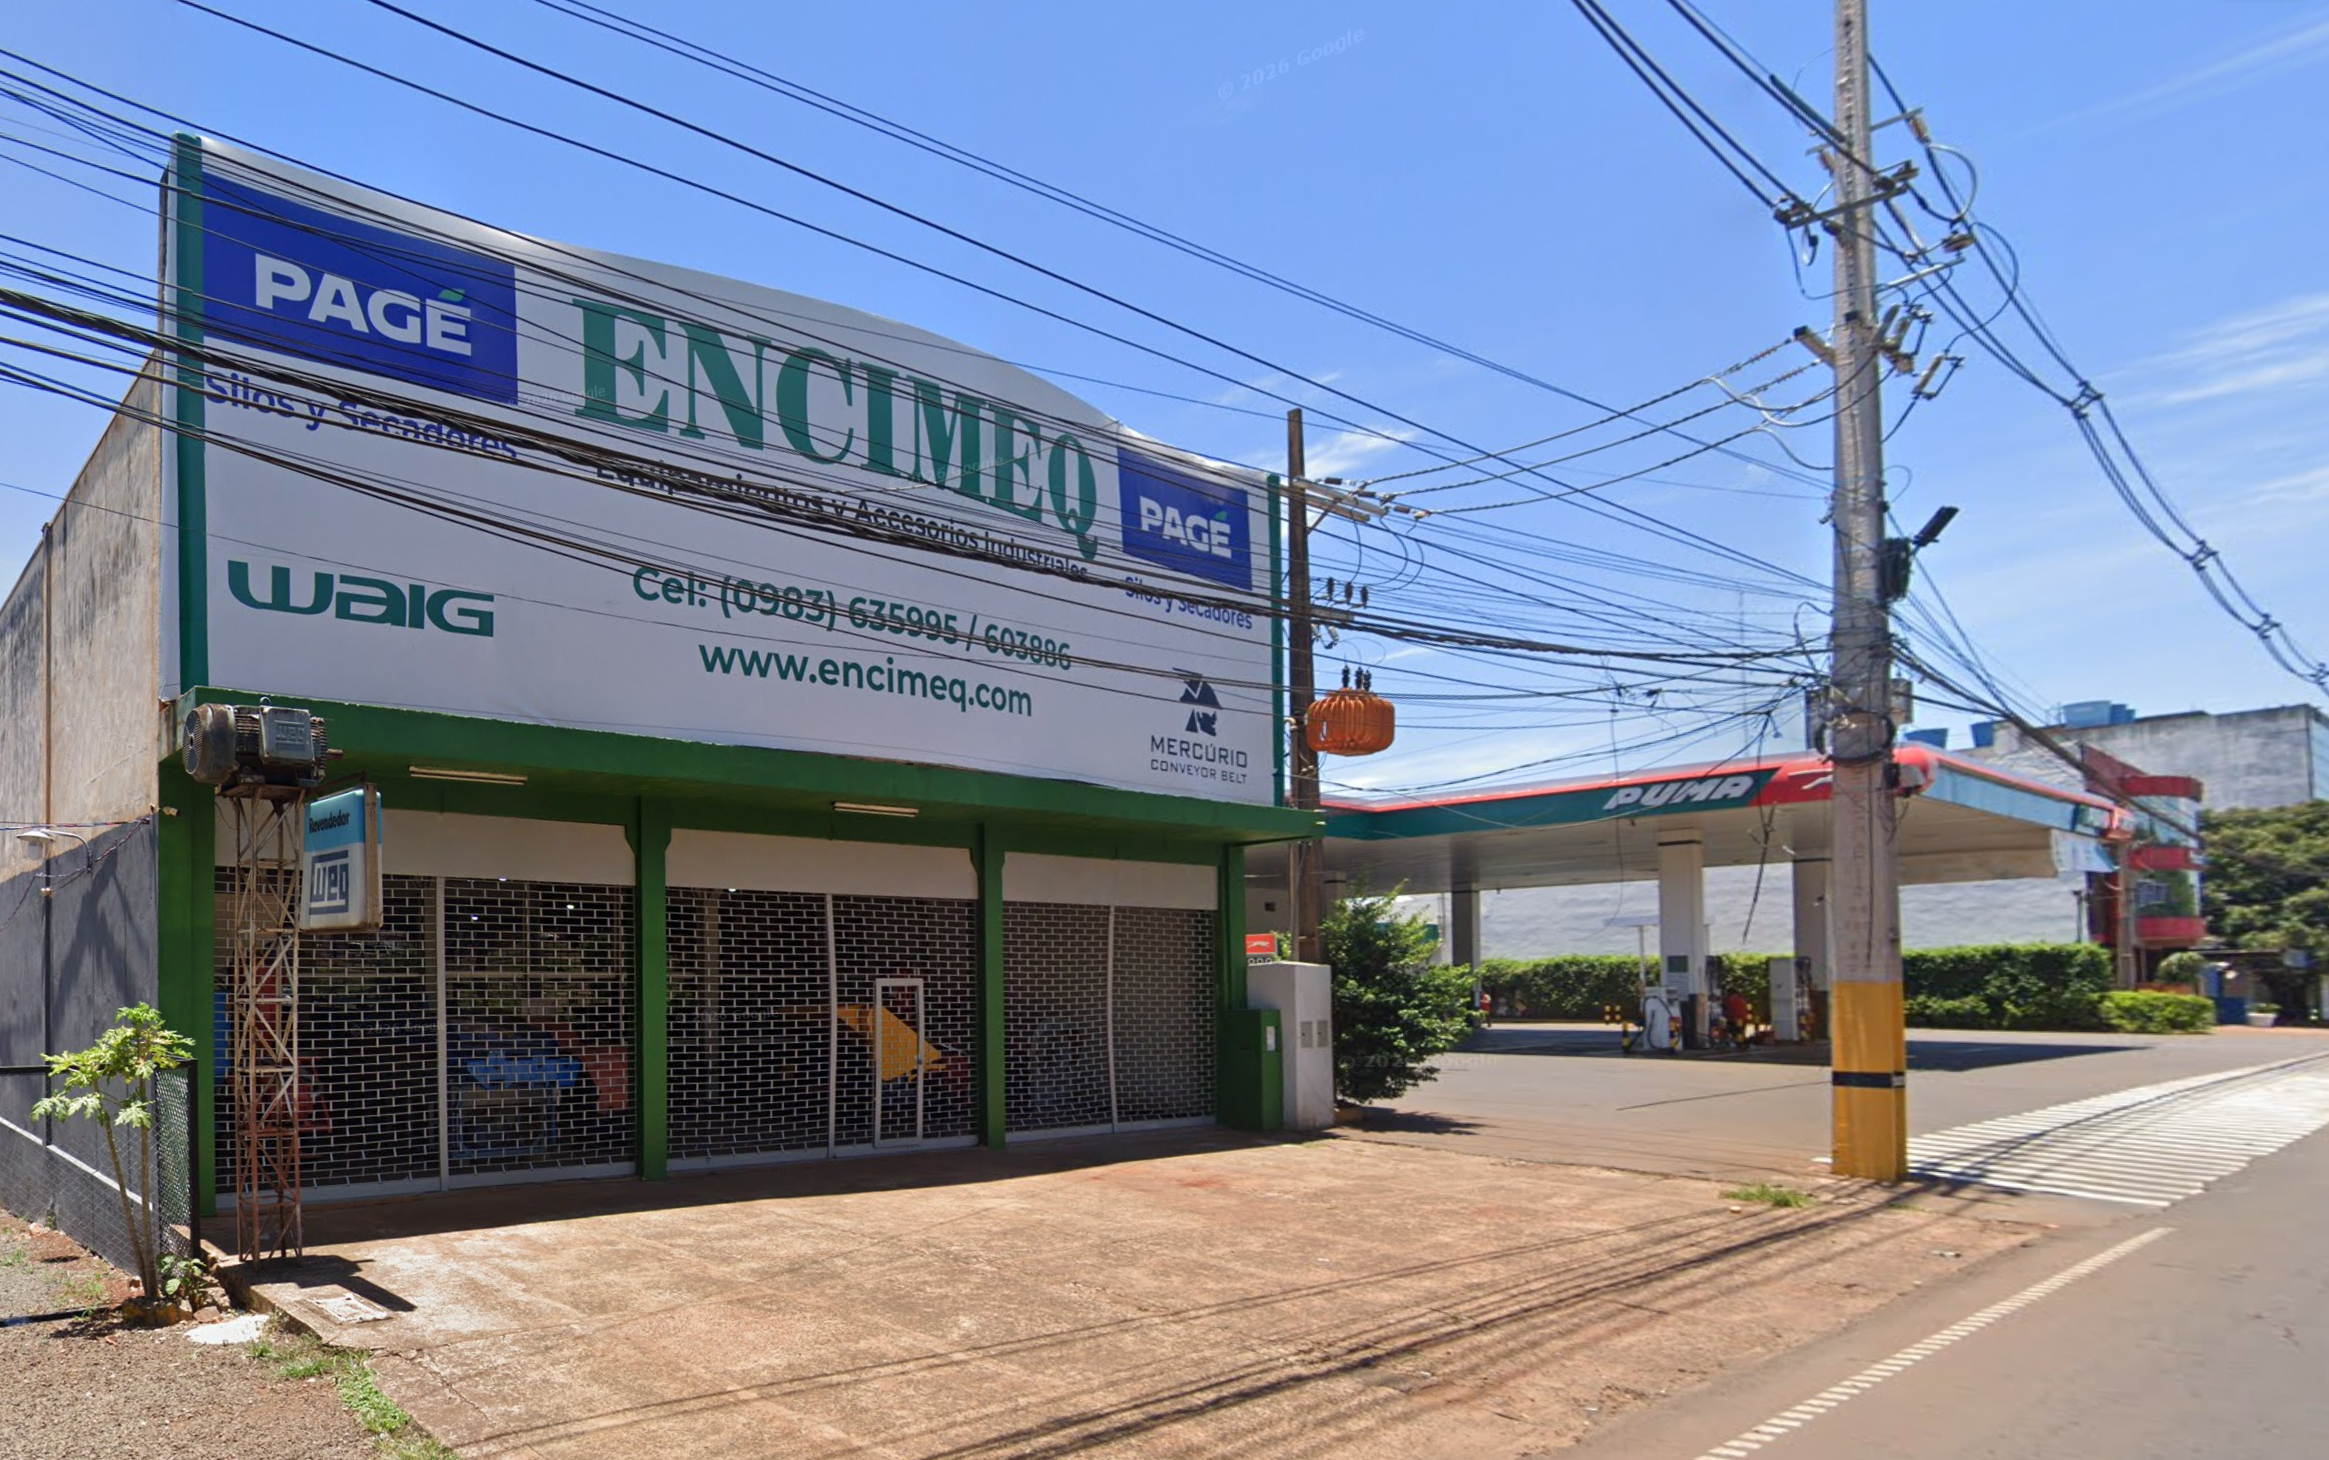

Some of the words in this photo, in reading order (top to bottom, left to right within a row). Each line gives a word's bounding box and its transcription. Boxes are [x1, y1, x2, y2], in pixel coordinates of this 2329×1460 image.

[254, 253, 473, 356] PAGÉ
[205, 371, 295, 418] Silos
[305, 399, 326, 431] y
[338, 400, 517, 458] Secadores
[572, 298, 1099, 560] ENCIMEQ
[854, 499, 979, 552] Accesorios
[1139, 495, 1232, 559] PAGÉ
[632, 566, 707, 608] Cel:
[720, 575, 837, 632] (0983)
[847, 596, 959, 645] 635995
[964, 613, 977, 652] /
[983, 623, 1072, 671] 603886
[698, 644, 1033, 717] www.encimeq.com
[1150, 734, 1248, 768] MERCÚRIO
[1150, 759, 1217, 779] CONVEYOR
[1220, 769, 1248, 784] BELT
[308, 809, 351, 835] Revendedor
[1602, 774, 1754, 810] PUMA
